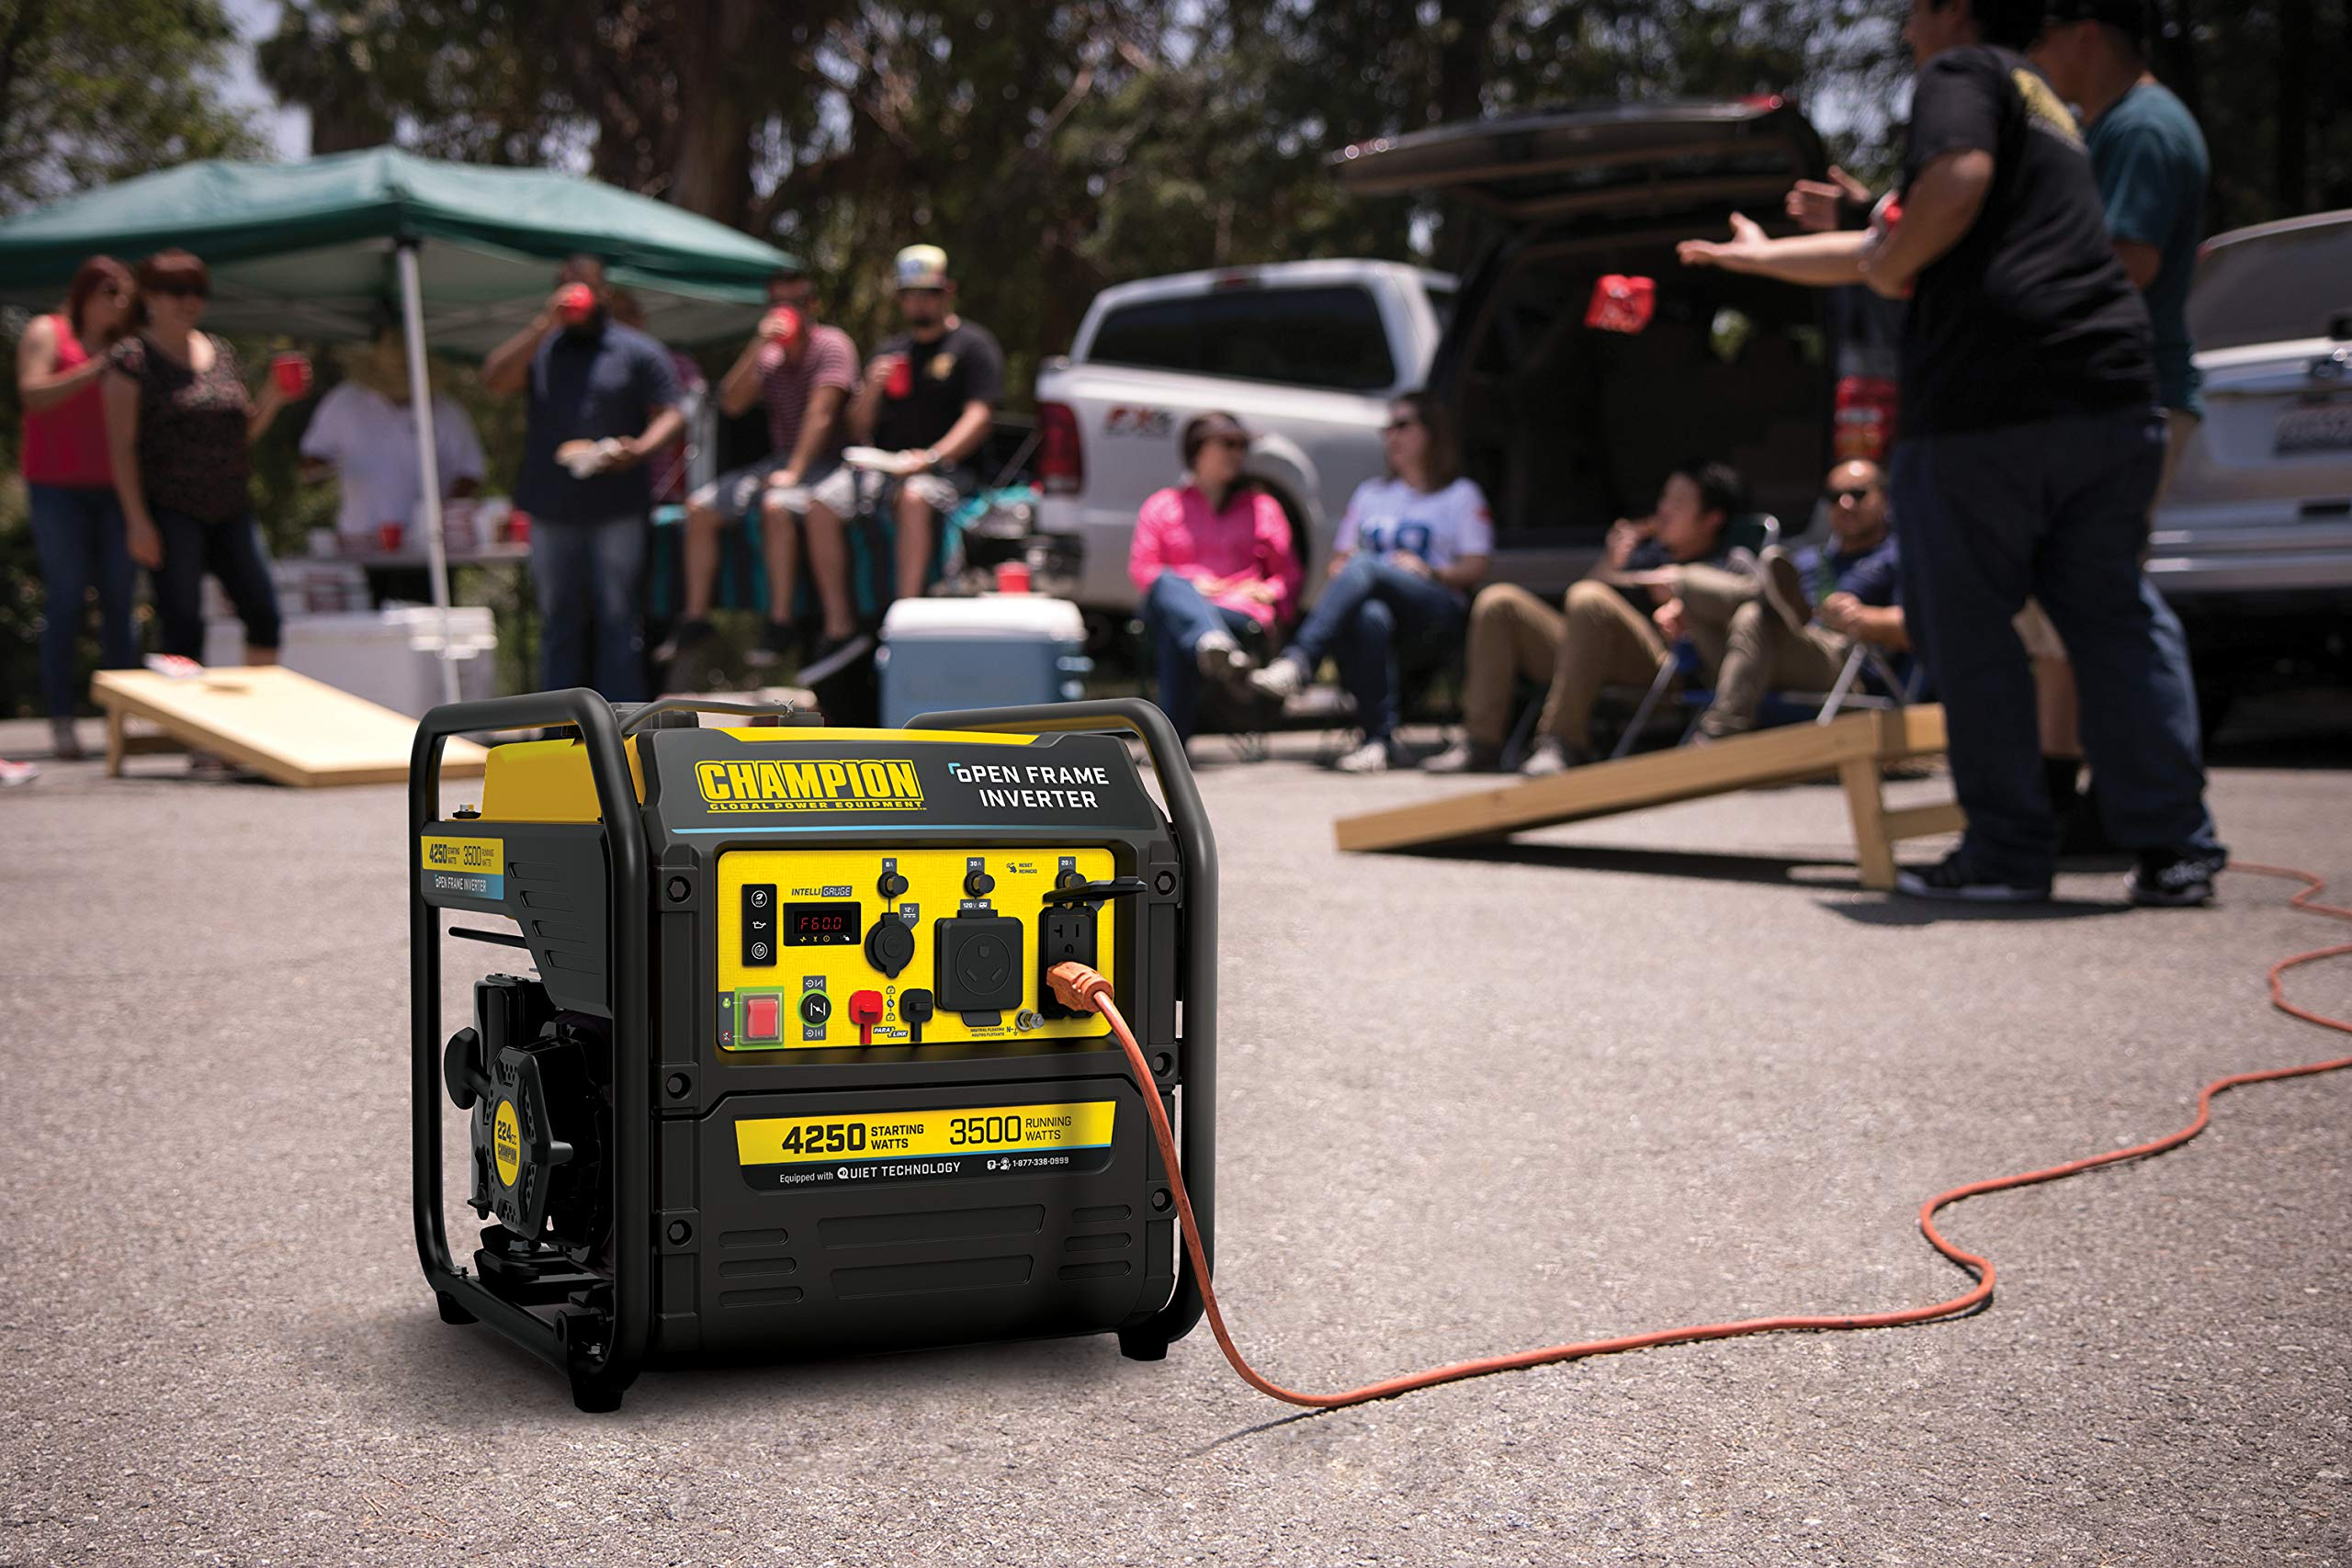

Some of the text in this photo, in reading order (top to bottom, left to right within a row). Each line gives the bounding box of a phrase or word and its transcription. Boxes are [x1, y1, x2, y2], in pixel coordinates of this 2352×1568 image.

[698, 763, 919, 799] CHAMPION
[1025, 766, 1110, 784] FRAME
[835, 801, 922, 809] EQUIPMENT
[978, 789, 1099, 808] INVERTER
[429, 843, 447, 863] 4250
[464, 845, 481, 866] 3500
[447, 877, 464, 890] FRAME
[870, 1123, 924, 1137] STARTING
[949, 1115, 1022, 1145] 3500
[1025, 1116, 1072, 1128] RUNNING
[782, 1122, 866, 1155] 4250
[871, 1138, 909, 1150] WATTS
[1025, 1129, 1061, 1142] WATTS
[780, 1162, 961, 1184] Equipped with QUIET TECHNOLOGY
